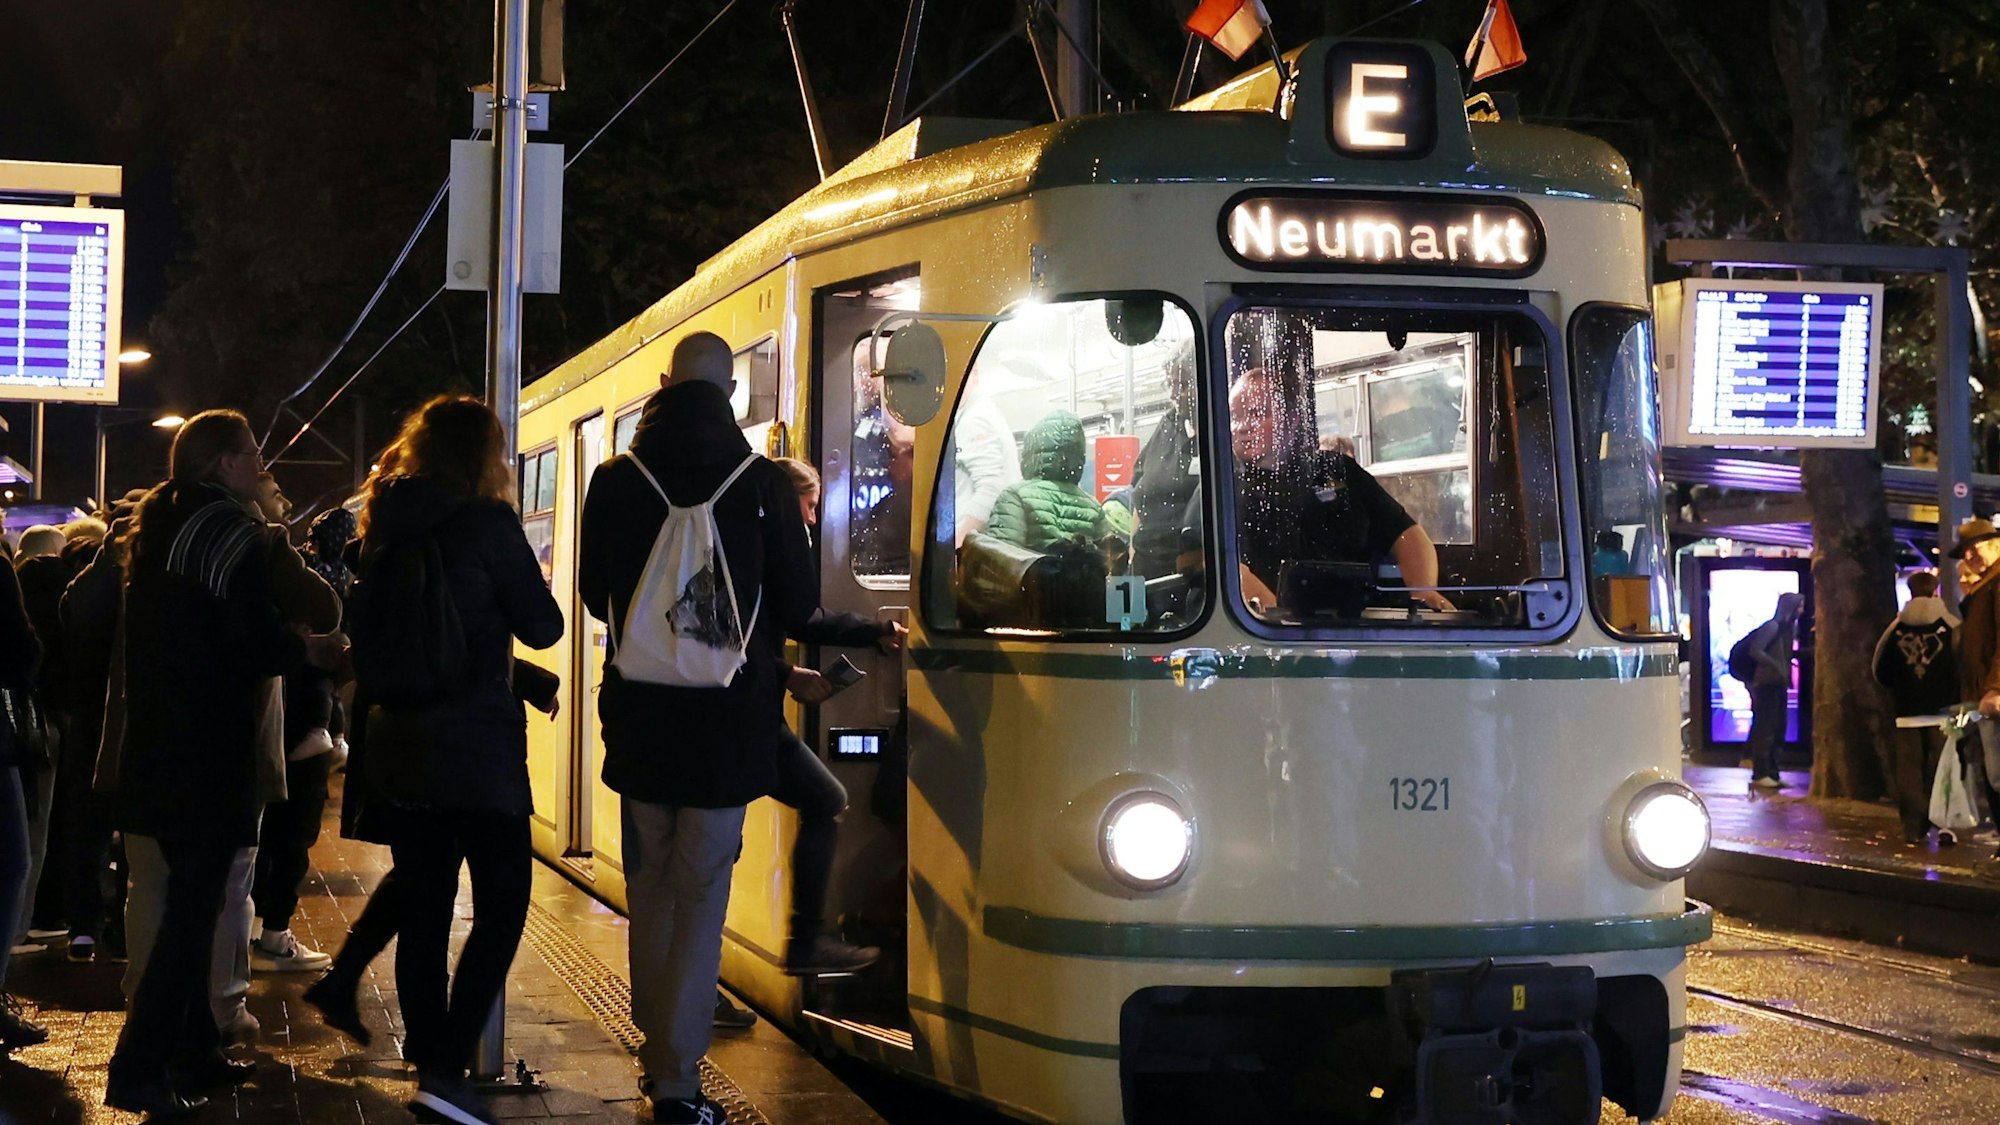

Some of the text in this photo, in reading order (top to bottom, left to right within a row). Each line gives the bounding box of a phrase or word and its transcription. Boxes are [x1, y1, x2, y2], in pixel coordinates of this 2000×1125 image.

[1350, 62, 1408, 147] E
[1233, 204, 1529, 263] Neumarkt
[1115, 581, 1131, 614] 1
[1389, 777, 1449, 811] 1321
